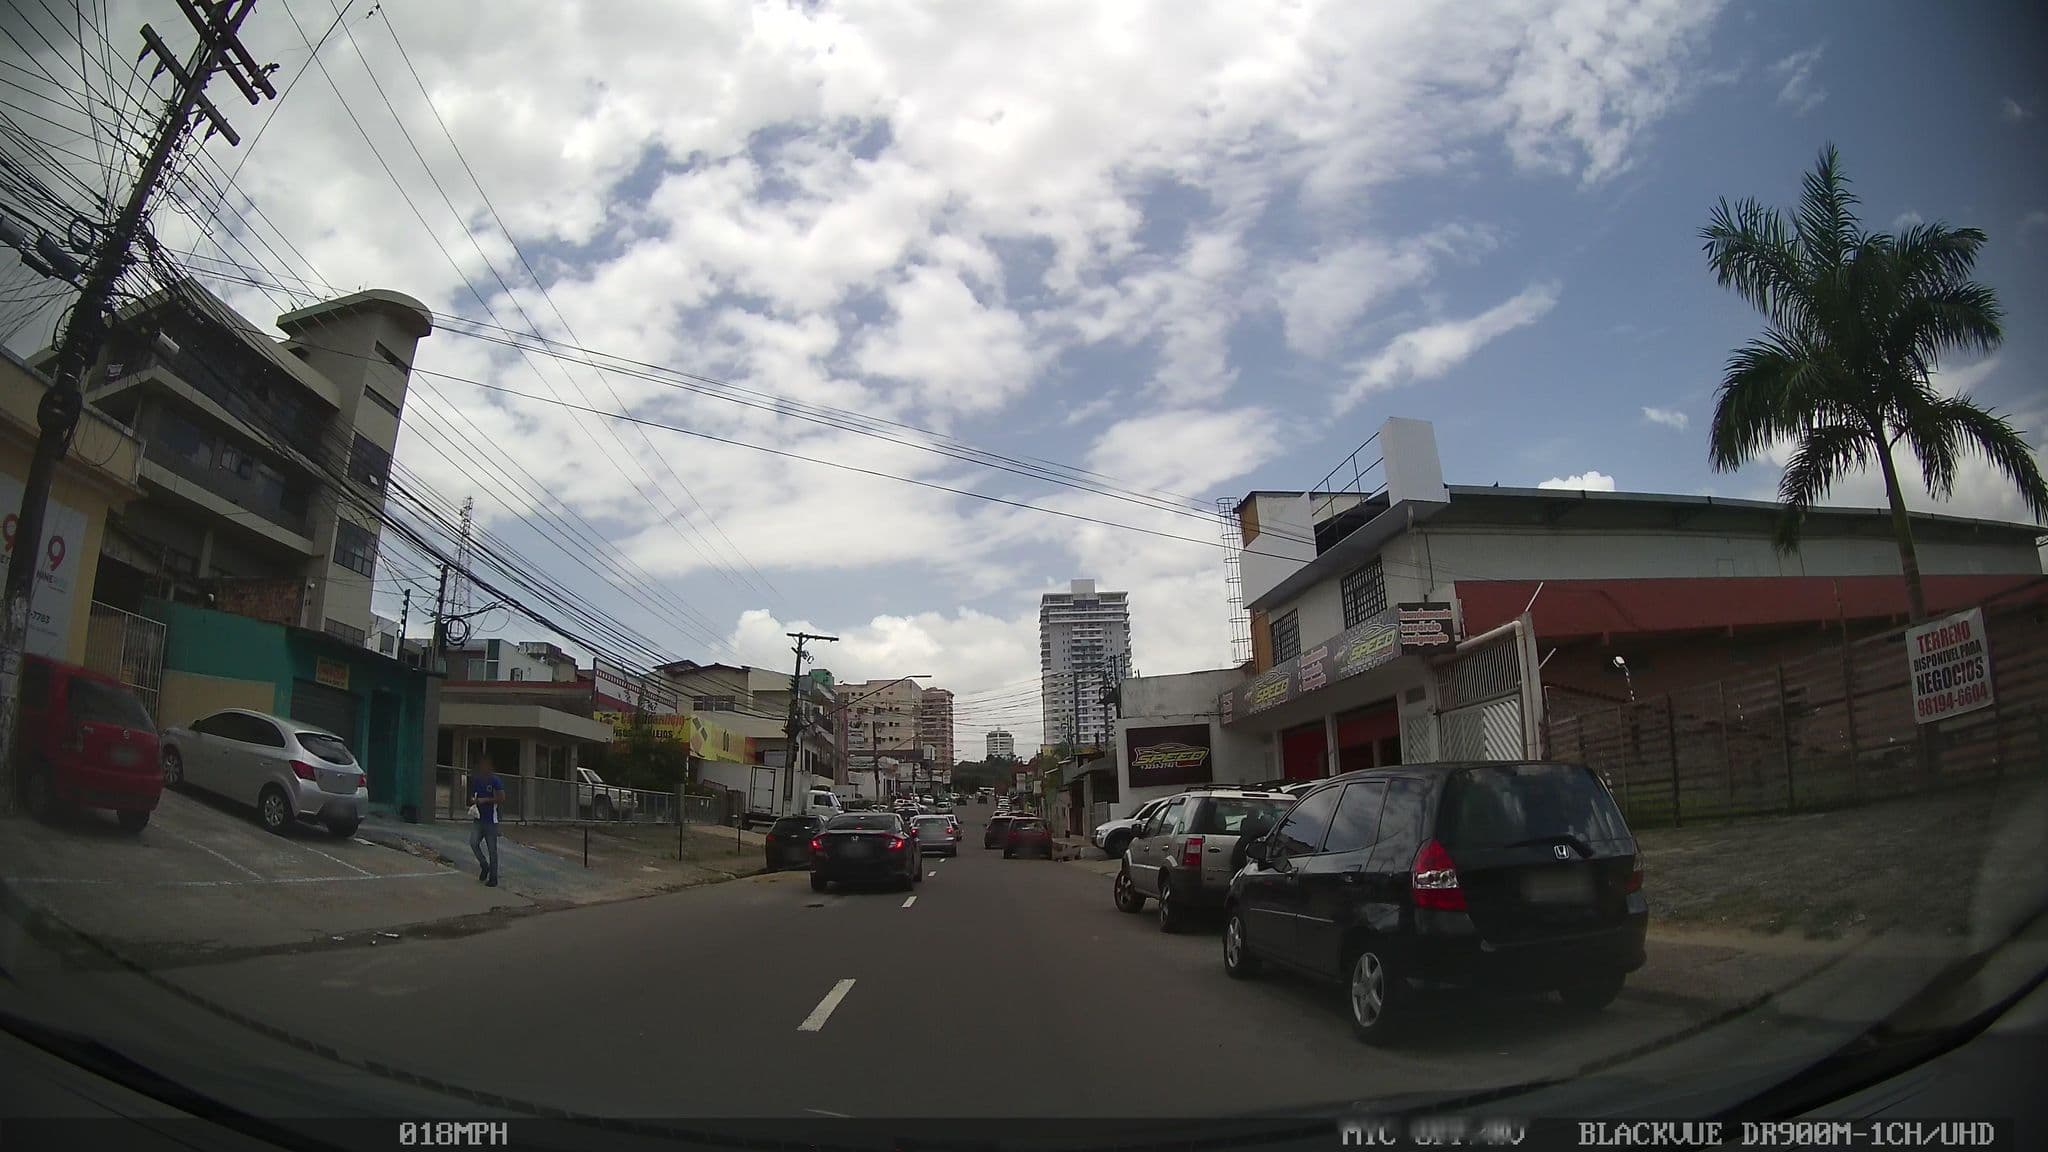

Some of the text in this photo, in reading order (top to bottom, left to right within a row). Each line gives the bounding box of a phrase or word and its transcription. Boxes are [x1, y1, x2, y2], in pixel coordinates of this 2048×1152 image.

[1349, 629, 1396, 662] SPEED
[1916, 620, 1971, 654] TERRENO
[1960, 639, 1983, 658] PARA
[1255, 677, 1289, 705] SPEED
[1136, 750, 1207, 765] SPEED
